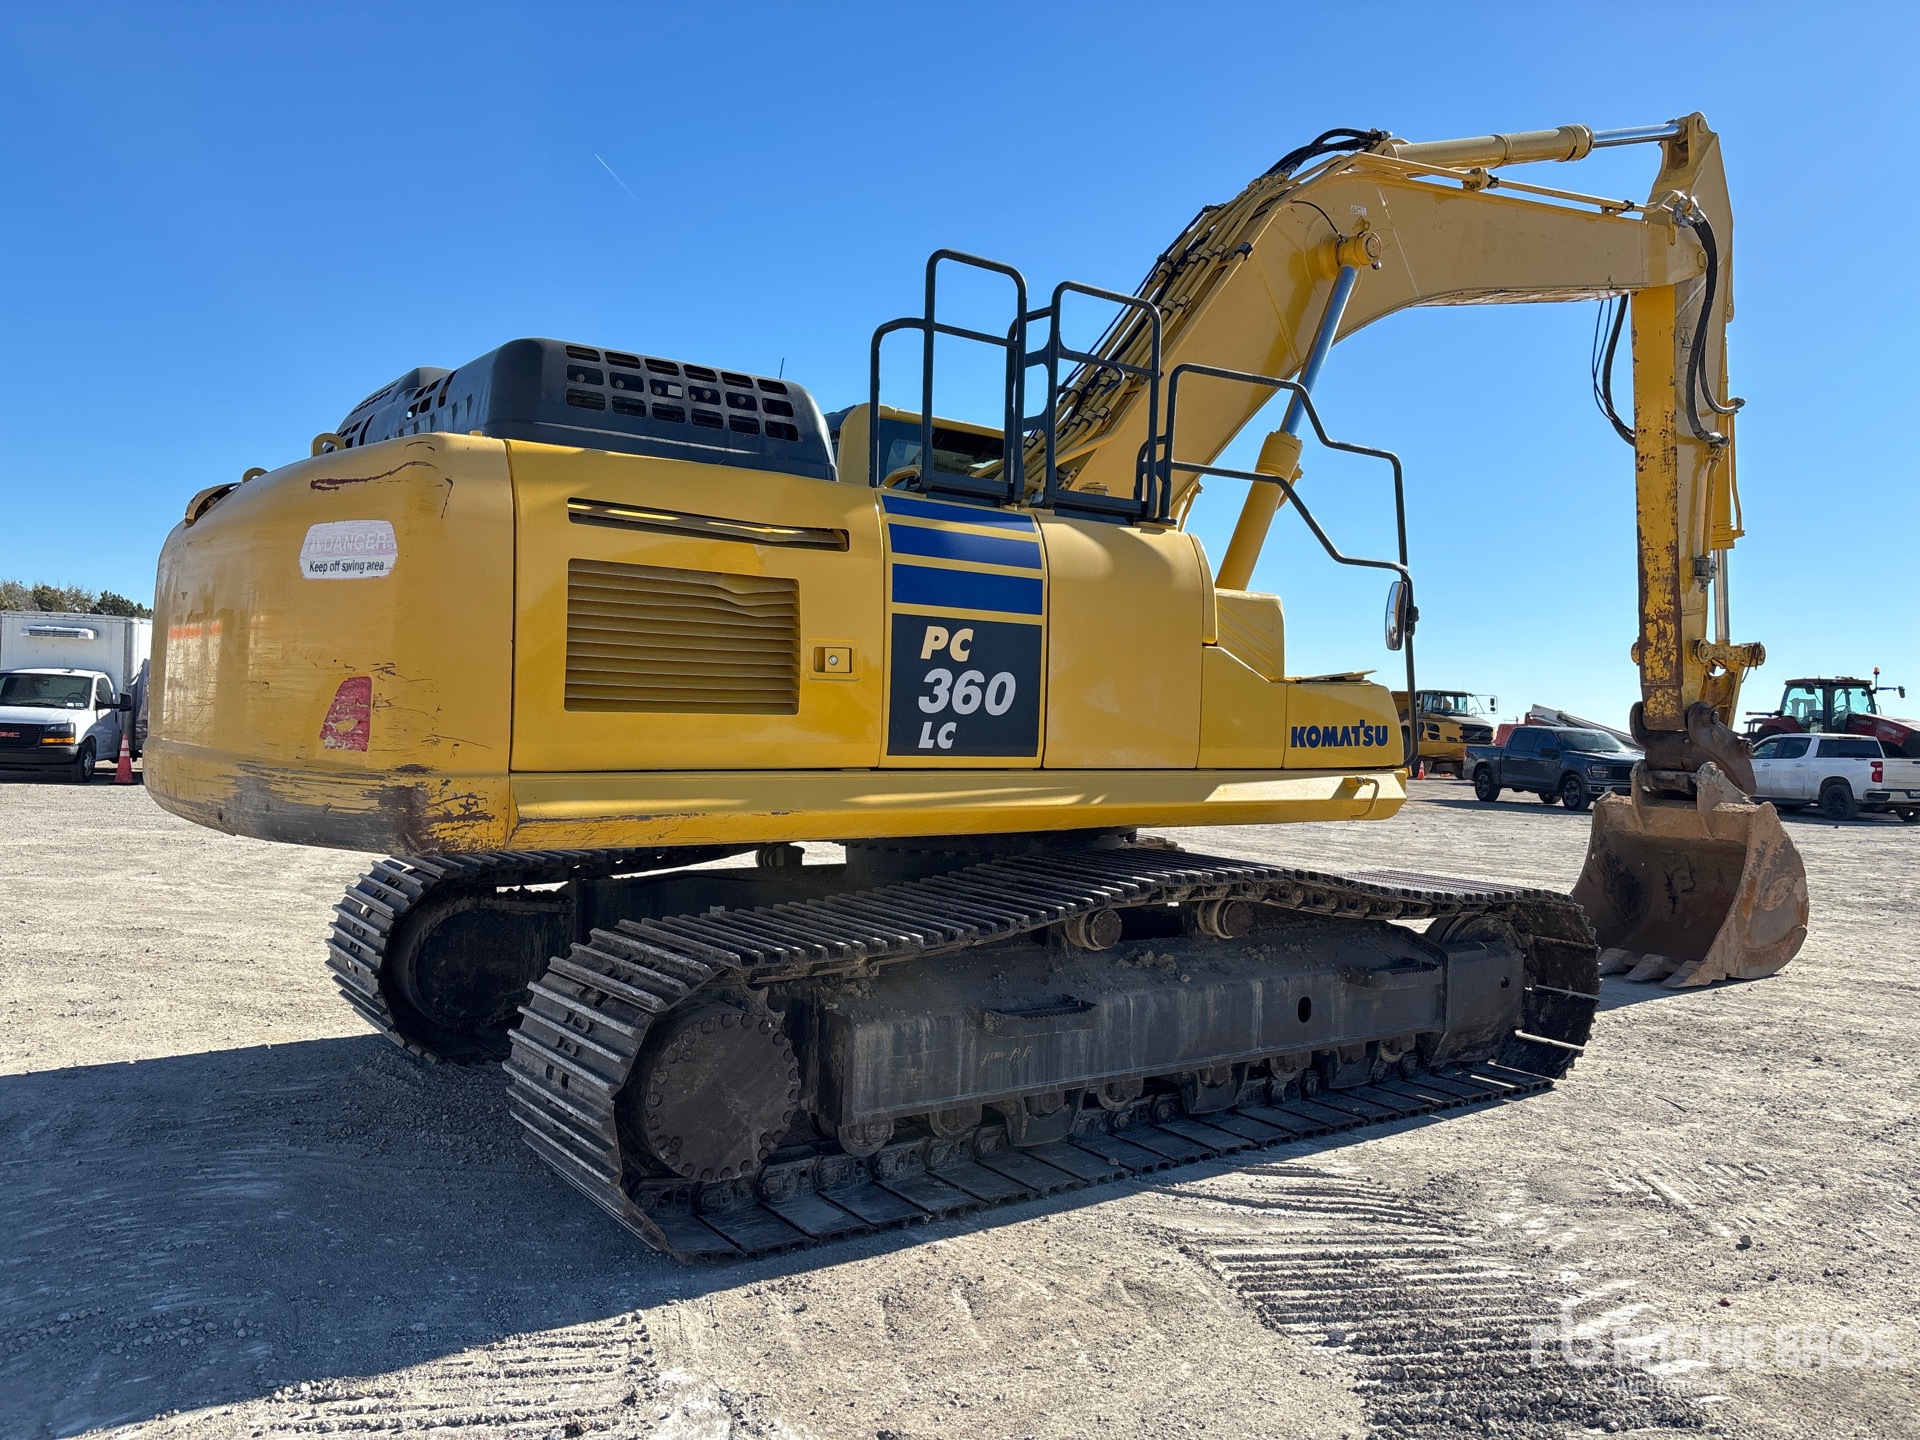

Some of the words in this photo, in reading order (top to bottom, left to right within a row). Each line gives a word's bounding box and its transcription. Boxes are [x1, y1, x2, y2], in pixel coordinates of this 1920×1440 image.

[323, 532, 387, 552] DANGER
[309, 561, 328, 575] Keep
[330, 560, 341, 572] off
[341, 559, 365, 574] swing
[366, 560, 385, 571] area
[920, 625, 975, 662] PC
[917, 667, 1017, 717] 360
[917, 721, 957, 749] LC
[1290, 719, 1389, 749] KOMATSU
